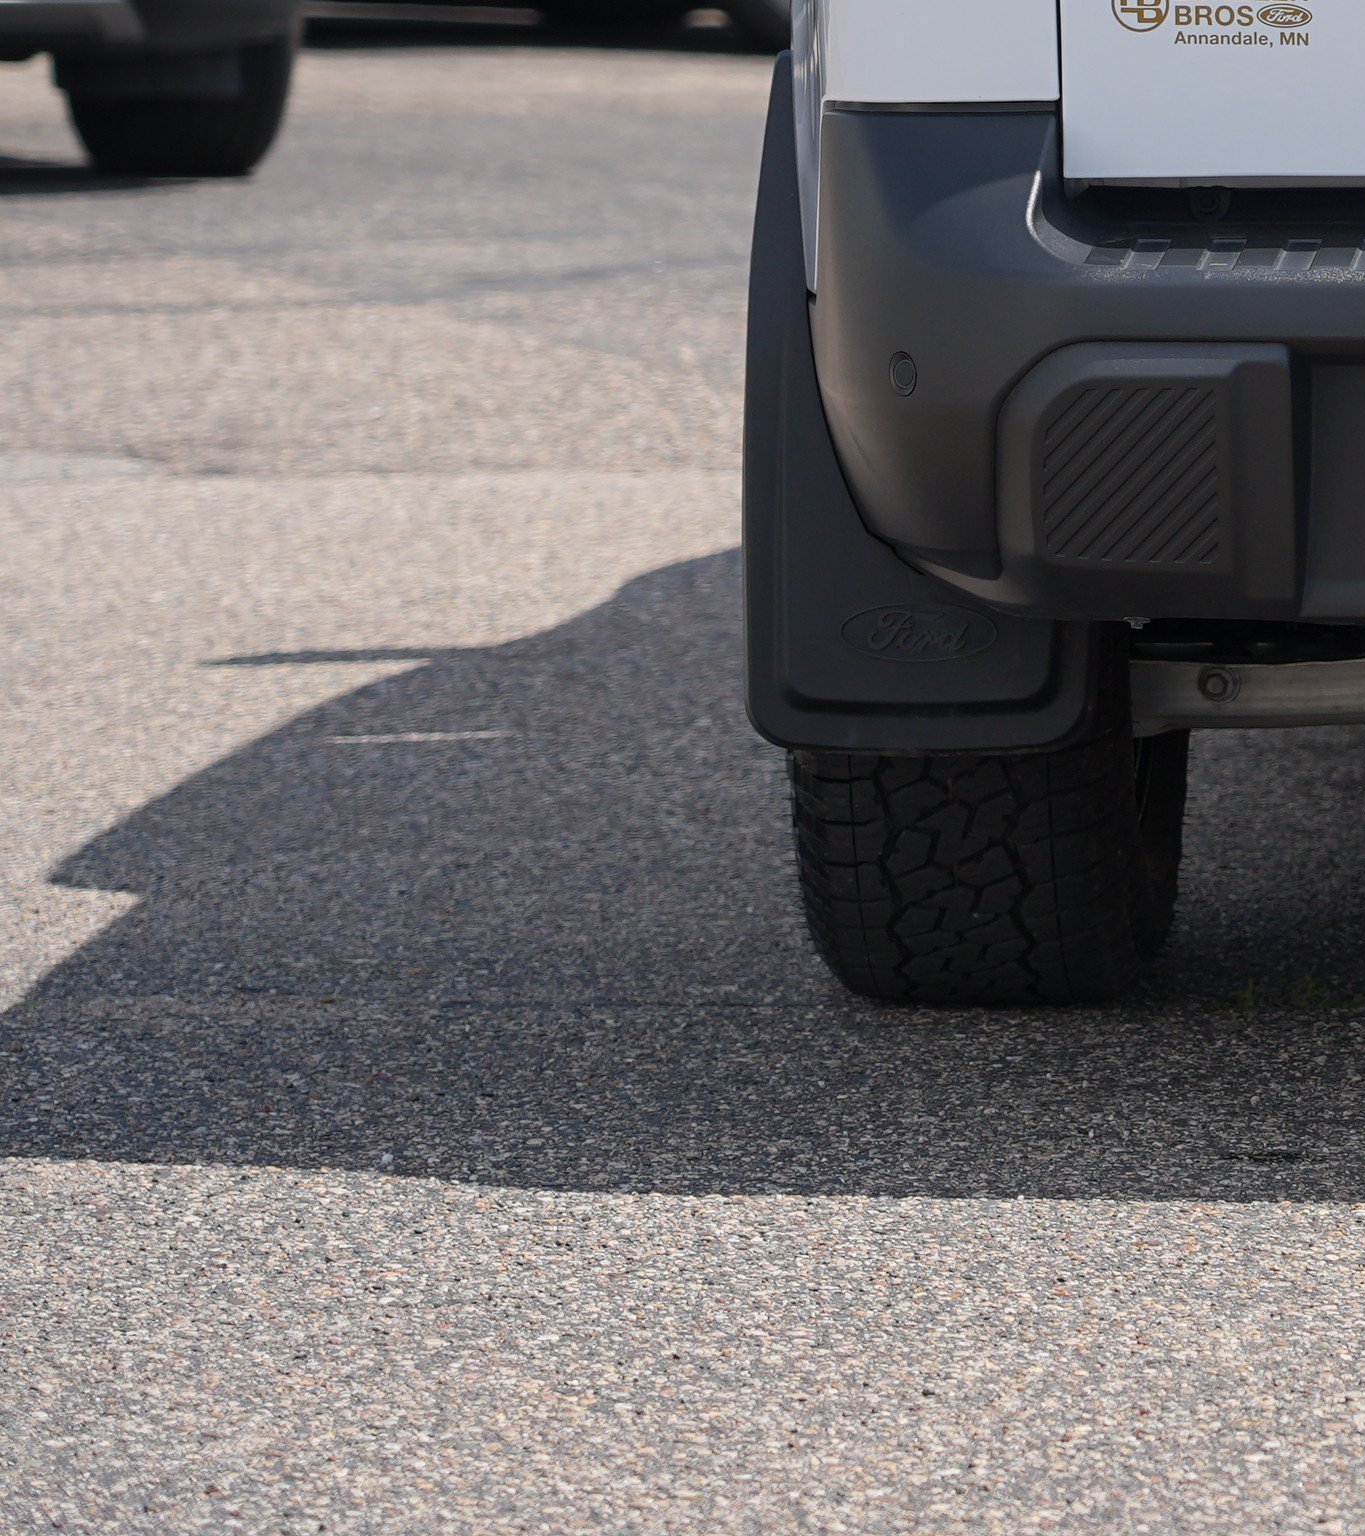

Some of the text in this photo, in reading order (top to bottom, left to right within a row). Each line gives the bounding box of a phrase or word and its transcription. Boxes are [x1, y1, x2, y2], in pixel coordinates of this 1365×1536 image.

[1174, 5, 1304, 26] BROS Ford
[1174, 30, 1309, 48] Annandale, MN
[868, 610, 971, 652] Ford
